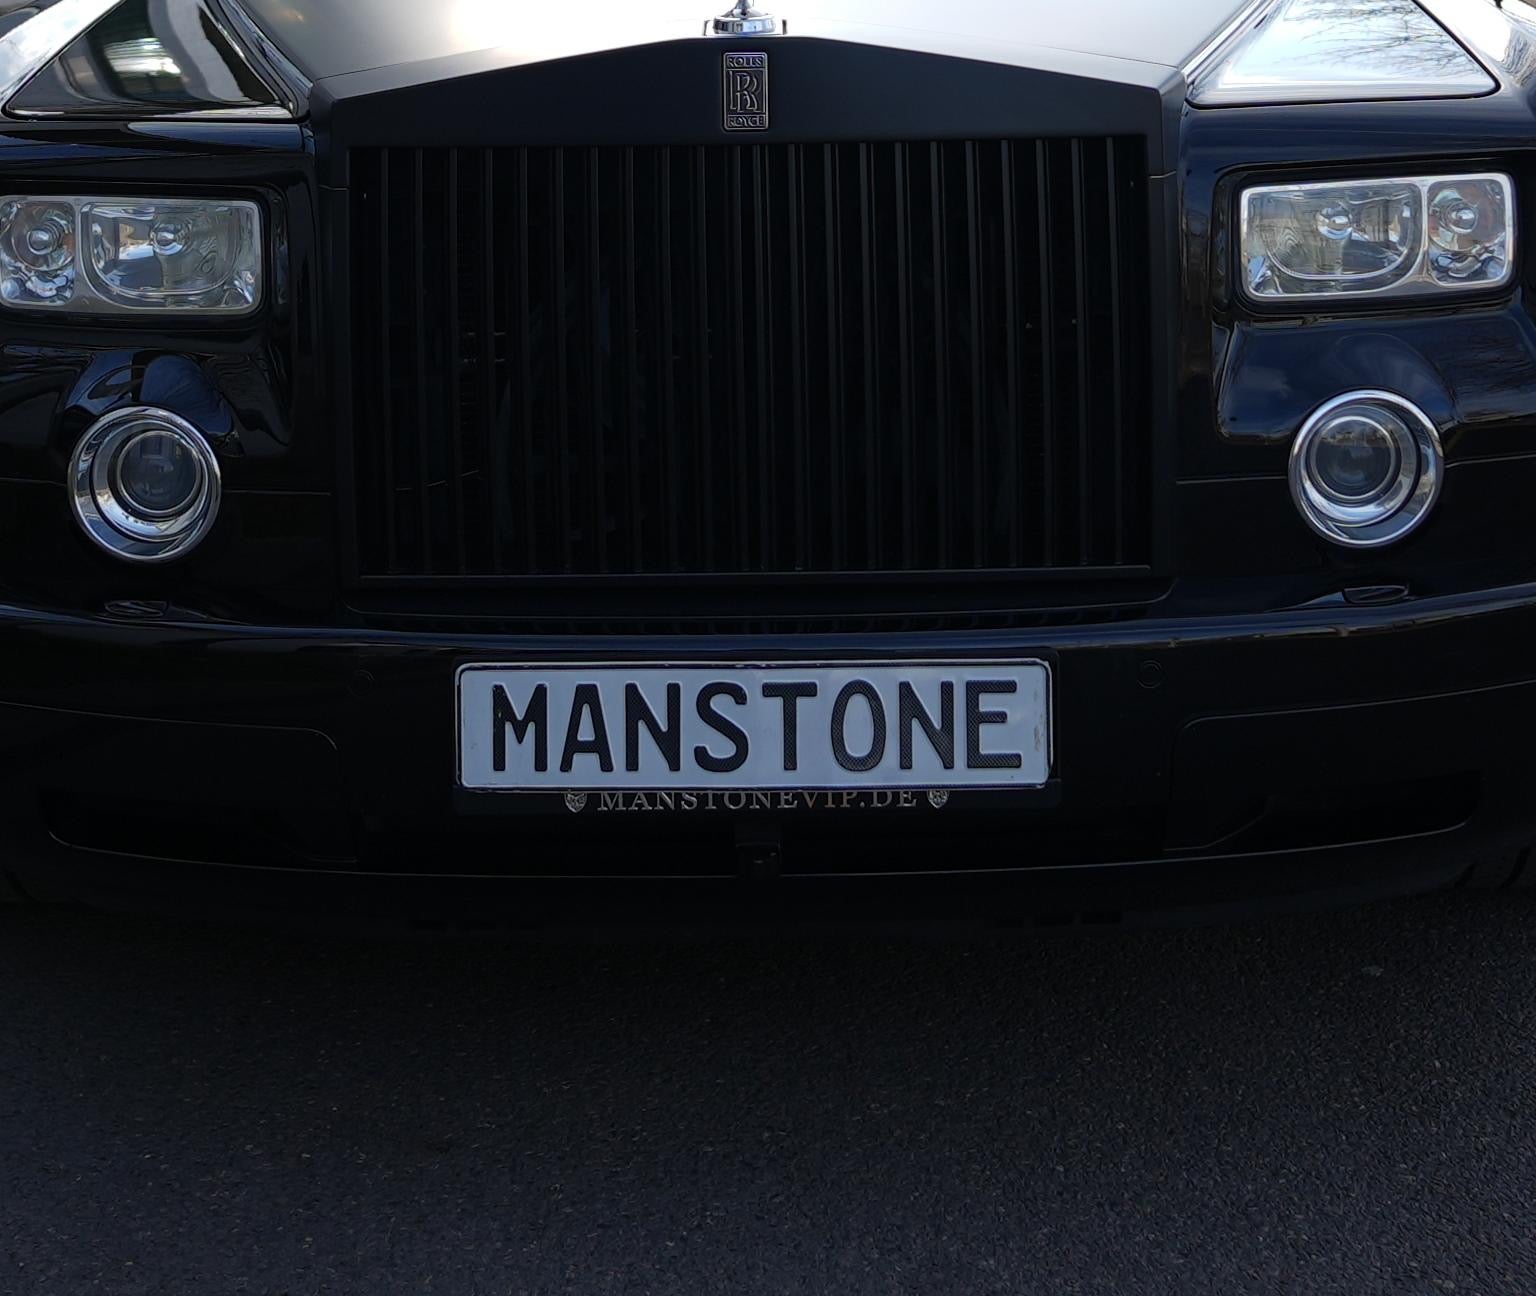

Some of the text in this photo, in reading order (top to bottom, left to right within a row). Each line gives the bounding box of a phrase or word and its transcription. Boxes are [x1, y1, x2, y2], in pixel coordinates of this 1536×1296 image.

[727, 57, 763, 68] ROLLS
[492, 679, 1022, 773] MANSTONE
[597, 790, 917, 811] MANSTONEVIP.DE
